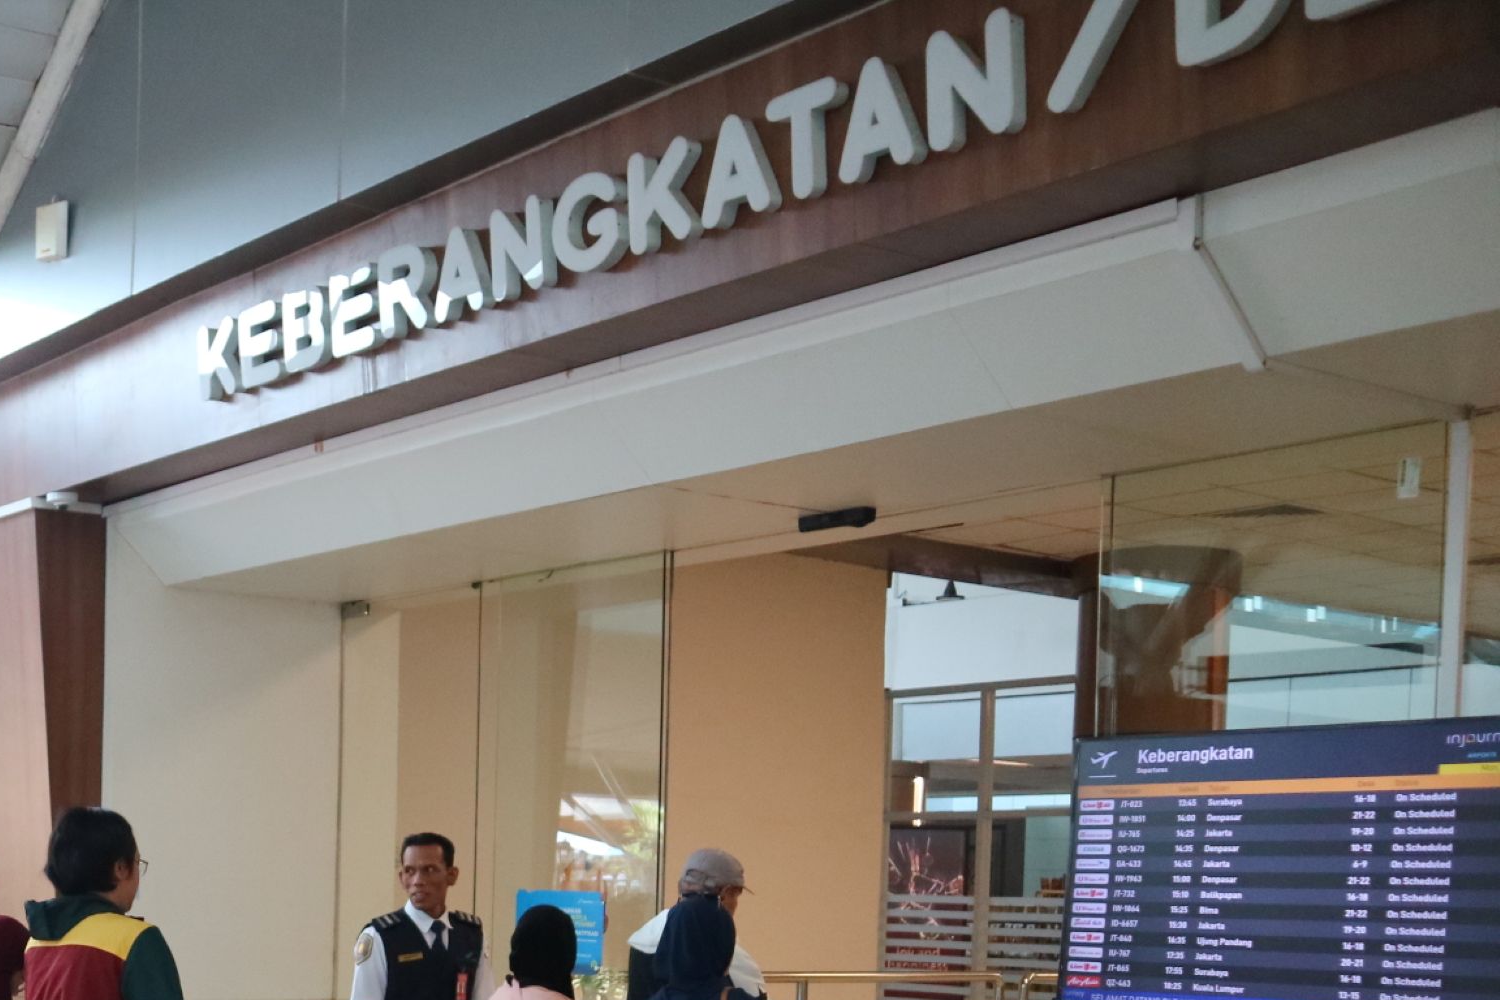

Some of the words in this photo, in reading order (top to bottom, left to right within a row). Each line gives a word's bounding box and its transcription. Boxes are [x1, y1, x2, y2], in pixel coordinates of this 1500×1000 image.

[193, 7, 1028, 403] KEBERANGKATAN
[1138, 746, 1254, 764] Keberangkatan
[1396, 794, 1408, 802] On
[1409, 793, 1457, 801] Scheduled
[1207, 814, 1242, 822] Denpasar
[1408, 810, 1455, 818] Scheduled
[1176, 829, 1194, 837] 14:25
[1393, 827, 1405, 835] On
[1406, 827, 1454, 835] Scheduled
[1204, 845, 1239, 853] Denpasar
[1405, 843, 1453, 851] Scheduled
[1391, 860, 1402, 868] On
[1404, 860, 1451, 868] Scheduled
[1202, 876, 1237, 884] Denpasar
[1389, 877, 1401, 885] On
[1402, 877, 1450, 885] Scheduled
[1200, 891, 1242, 900] Balikpapan
[1401, 894, 1448, 902] Scheduled
[1199, 906, 1219, 914] Bima
[1387, 910, 1398, 918] On
[1400, 911, 1447, 919] Scheduled
[1198, 922, 1225, 930] Jakarta
[1385, 927, 1397, 935] On
[1398, 927, 1445, 936] Scheduled
[1197, 937, 1220, 946] Ujung
[1220, 938, 1252, 948] Pandang
[1397, 944, 1444, 953] Scheduled
[1195, 953, 1222, 961] Jakarta
[1382, 960, 1394, 968] On
[1395, 961, 1443, 970] Scheduled
[1194, 968, 1229, 978] Surabaya
[1394, 977, 1441, 987] Scheduled
[1193, 984, 1215, 992] Kuala
[1215, 985, 1244, 994] Lumpur
[1379, 993, 1391, 1000] On
